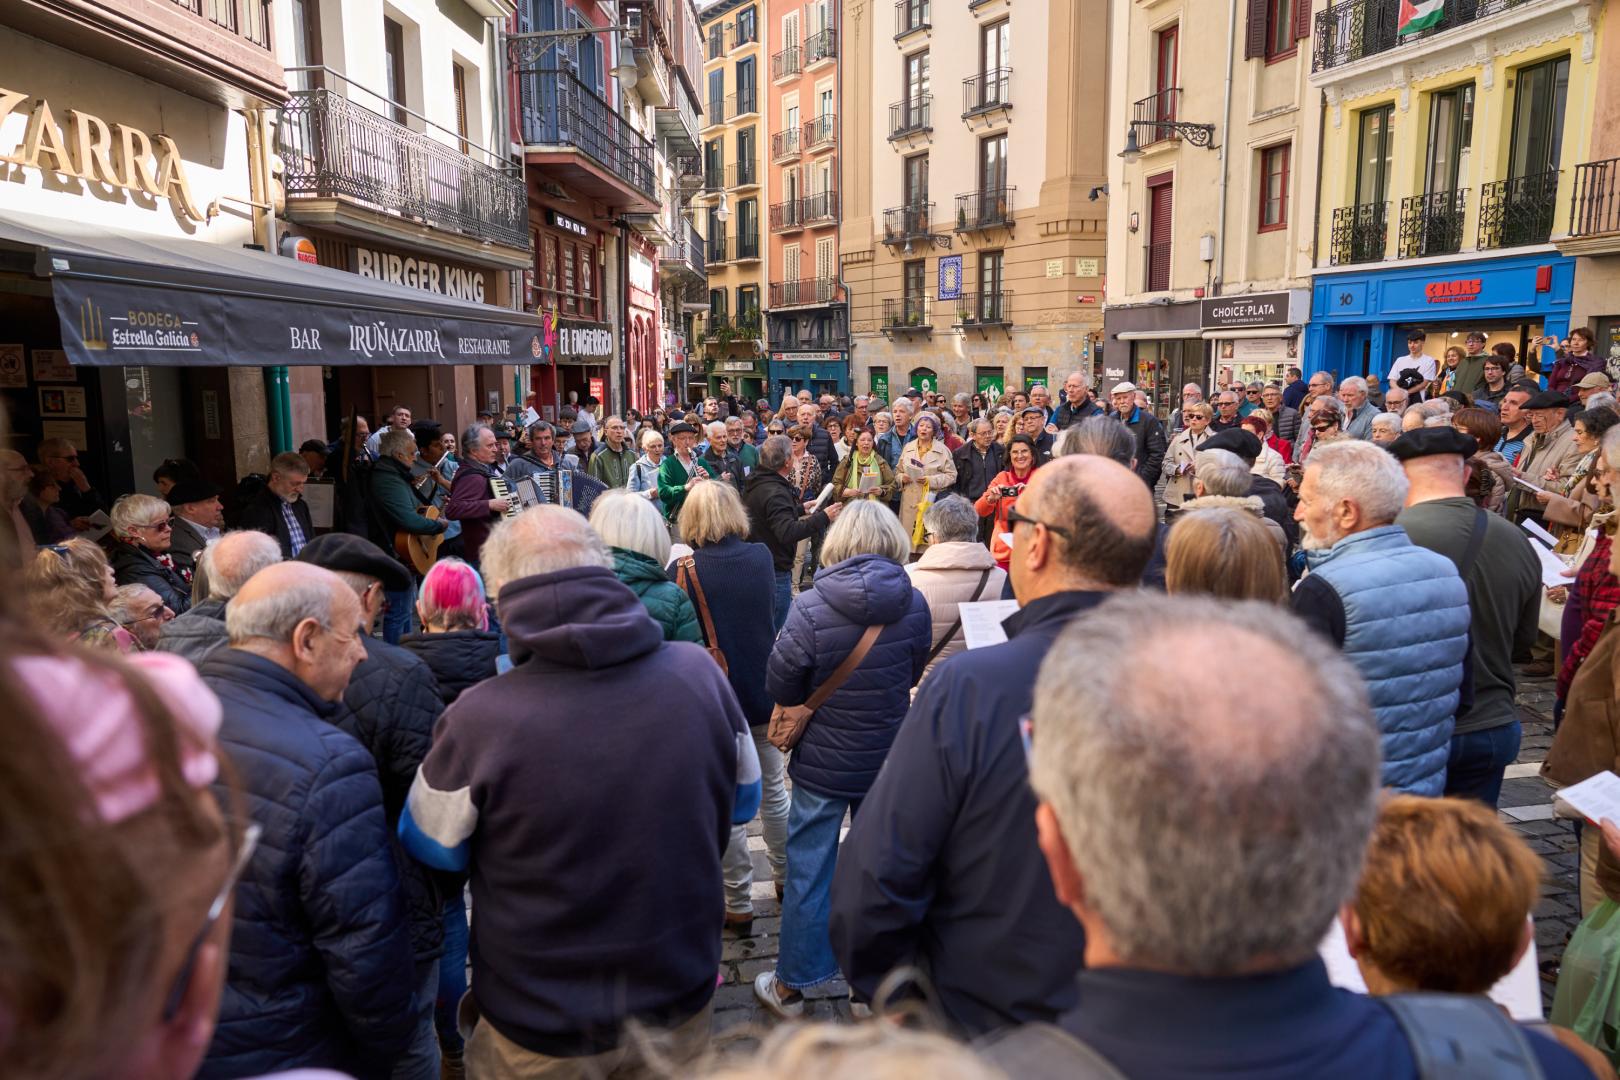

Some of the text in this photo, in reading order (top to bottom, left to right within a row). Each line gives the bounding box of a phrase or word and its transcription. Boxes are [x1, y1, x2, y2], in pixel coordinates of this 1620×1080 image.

[357, 247, 485, 304] BURGER KING
[128, 310, 181, 328] BODEGA
[112, 328, 190, 347] Estrella Galicia
[290, 321, 511, 358] BAR IRUÑAZARRA RESTAURANTE
[560, 327, 570, 355] EL
